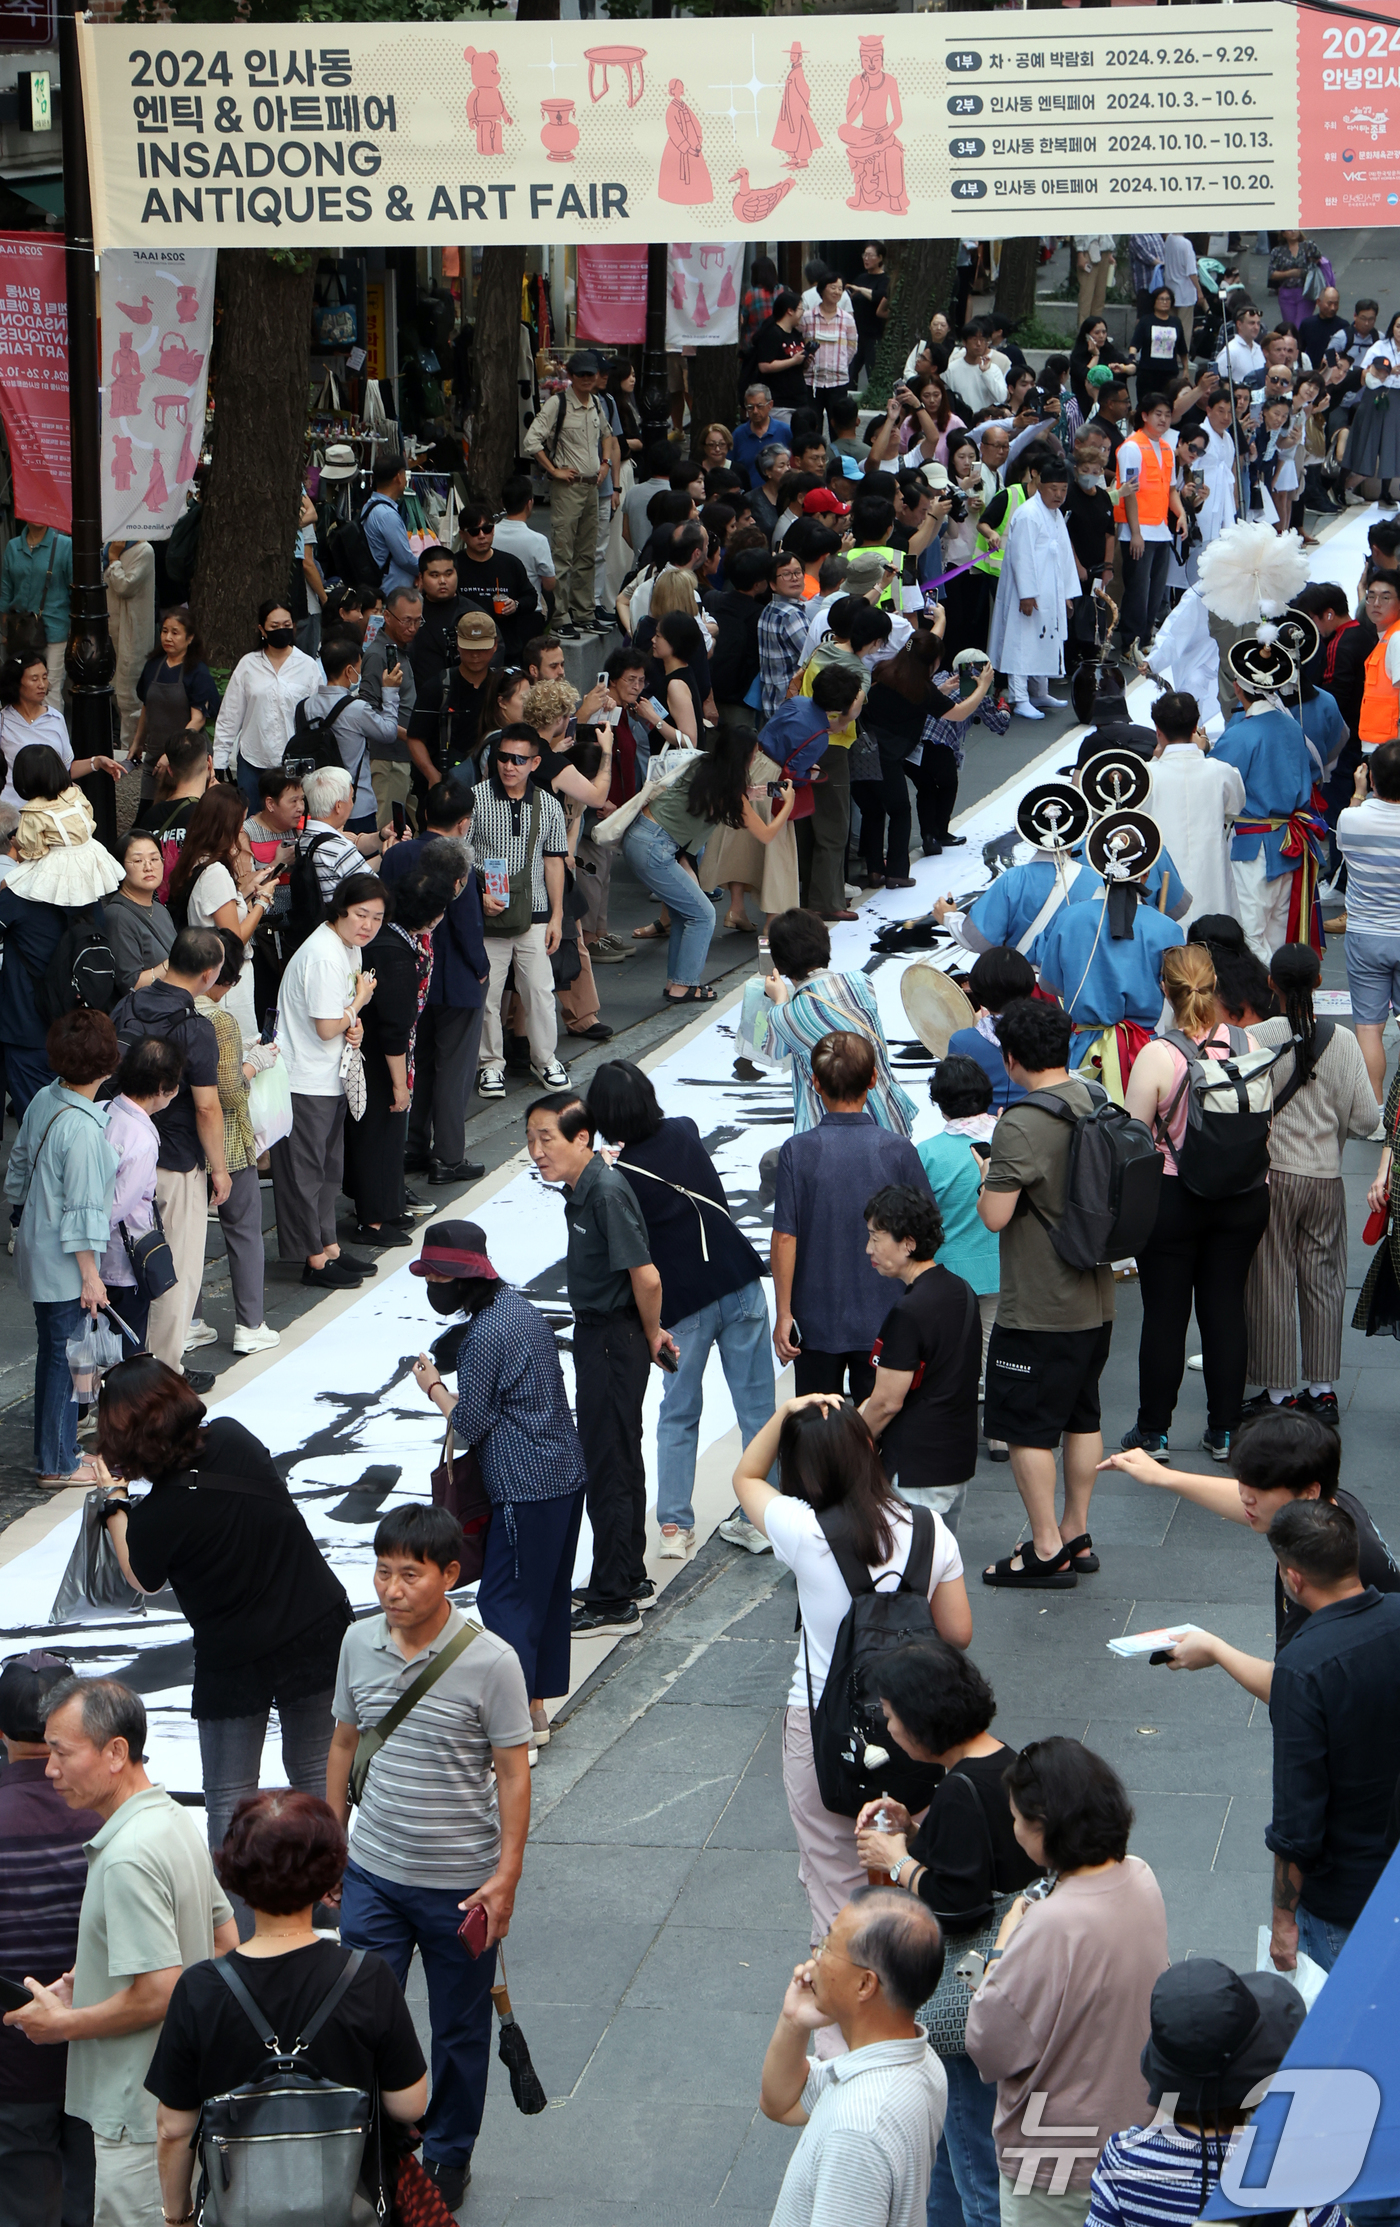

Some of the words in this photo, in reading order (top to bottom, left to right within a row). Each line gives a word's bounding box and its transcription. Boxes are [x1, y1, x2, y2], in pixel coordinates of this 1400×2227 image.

[954, 55, 974, 69] 1부
[1050, 50, 1095, 68] 박람회
[128, 49, 234, 88] 2024
[244, 48, 354, 88] 인사동
[955, 99, 975, 113] 2부
[990, 96, 1033, 113] 인사동
[1038, 94, 1096, 112] 엔틱페어
[134, 95, 205, 134] 엔틱
[214, 95, 243, 133] &
[253, 94, 397, 133] 아트페어
[1324, 121, 1337, 130] 주최
[1370, 124, 1387, 141] 종로
[957, 141, 976, 154] 3부
[992, 138, 1035, 155] 인사동
[1039, 136, 1097, 154] 한복페어
[137, 140, 382, 179] INSADONG
[1324, 151, 1337, 162] 후원
[1343, 170, 1367, 181] VKC
[959, 182, 978, 196] 4부
[994, 179, 1036, 196] 인사동
[1041, 177, 1098, 195] 아트페어
[141, 185, 373, 228] ANTIQUES
[386, 184, 415, 222] &
[428, 184, 516, 221] ART
[529, 182, 630, 220] FAIR
